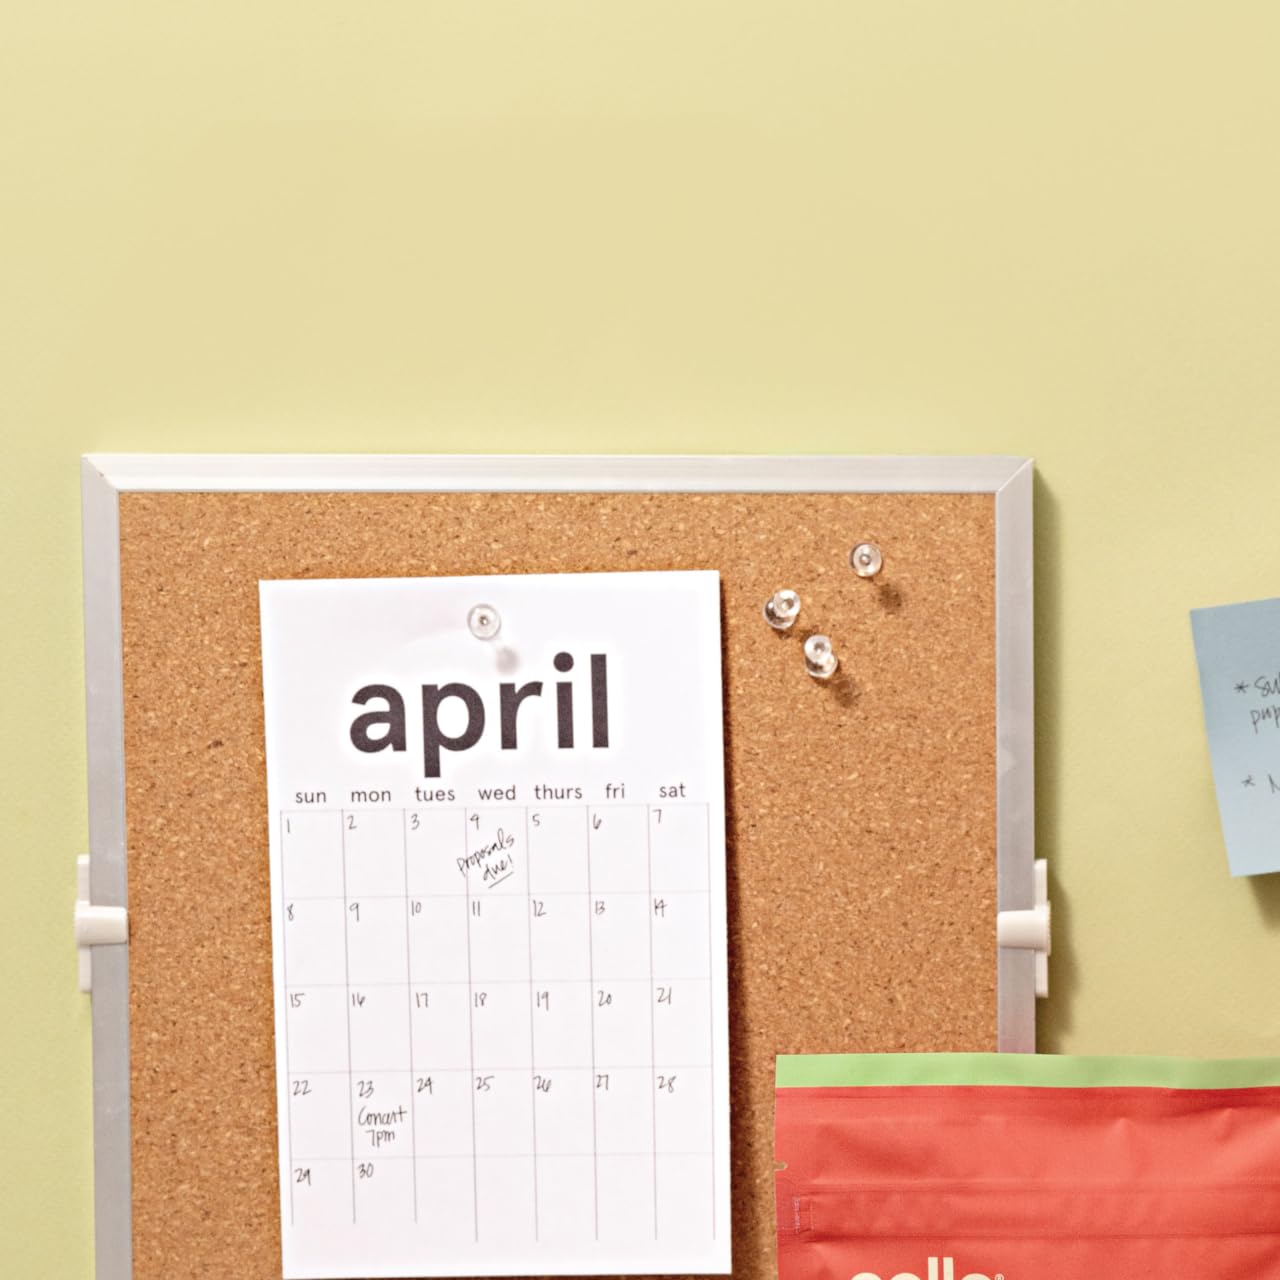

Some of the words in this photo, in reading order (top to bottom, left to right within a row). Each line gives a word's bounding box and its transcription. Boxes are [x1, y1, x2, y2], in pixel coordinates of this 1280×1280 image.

[349, 651, 609, 778] april
[295, 789, 327, 804] sun
[351, 788, 391, 803] mon
[415, 786, 455, 802] tues
[478, 784, 516, 801] wed
[534, 783, 583, 800] thurs
[605, 782, 625, 800] fri
[658, 782, 686, 799] sat
[286, 819, 291, 833] 1
[346, 815, 357, 830] 2
[411, 814, 420, 830] 3
[531, 813, 540, 828] 5
[592, 813, 602, 831] 6
[652, 808, 663, 824] 7
[286, 902, 294, 921] 8
[350, 902, 360, 921] 9
[411, 900, 422, 917] 10
[472, 901, 481, 917] 11
[532, 900, 547, 918] 12
[595, 900, 606, 916] 13
[653, 899, 668, 918] 14
[290, 992, 305, 1009] 15
[351, 992, 366, 1008] 16
[415, 992, 430, 1009] 17
[474, 992, 487, 1008] 18
[536, 992, 550, 1011] 19
[597, 989, 613, 1007] 20
[656, 987, 672, 1006] 21
[292, 1079, 312, 1097] 22
[357, 1080, 375, 1099] 23
[416, 1076, 433, 1096] 24
[476, 1075, 495, 1093] 25
[532, 1075, 552, 1094] 26
[594, 1074, 609, 1092] 27
[657, 1075, 676, 1093] 28
[357, 1105, 408, 1128] Concert
[365, 1130, 396, 1149] 7pm
[294, 1168, 312, 1186] 29
[358, 1163, 374, 1180] 30
